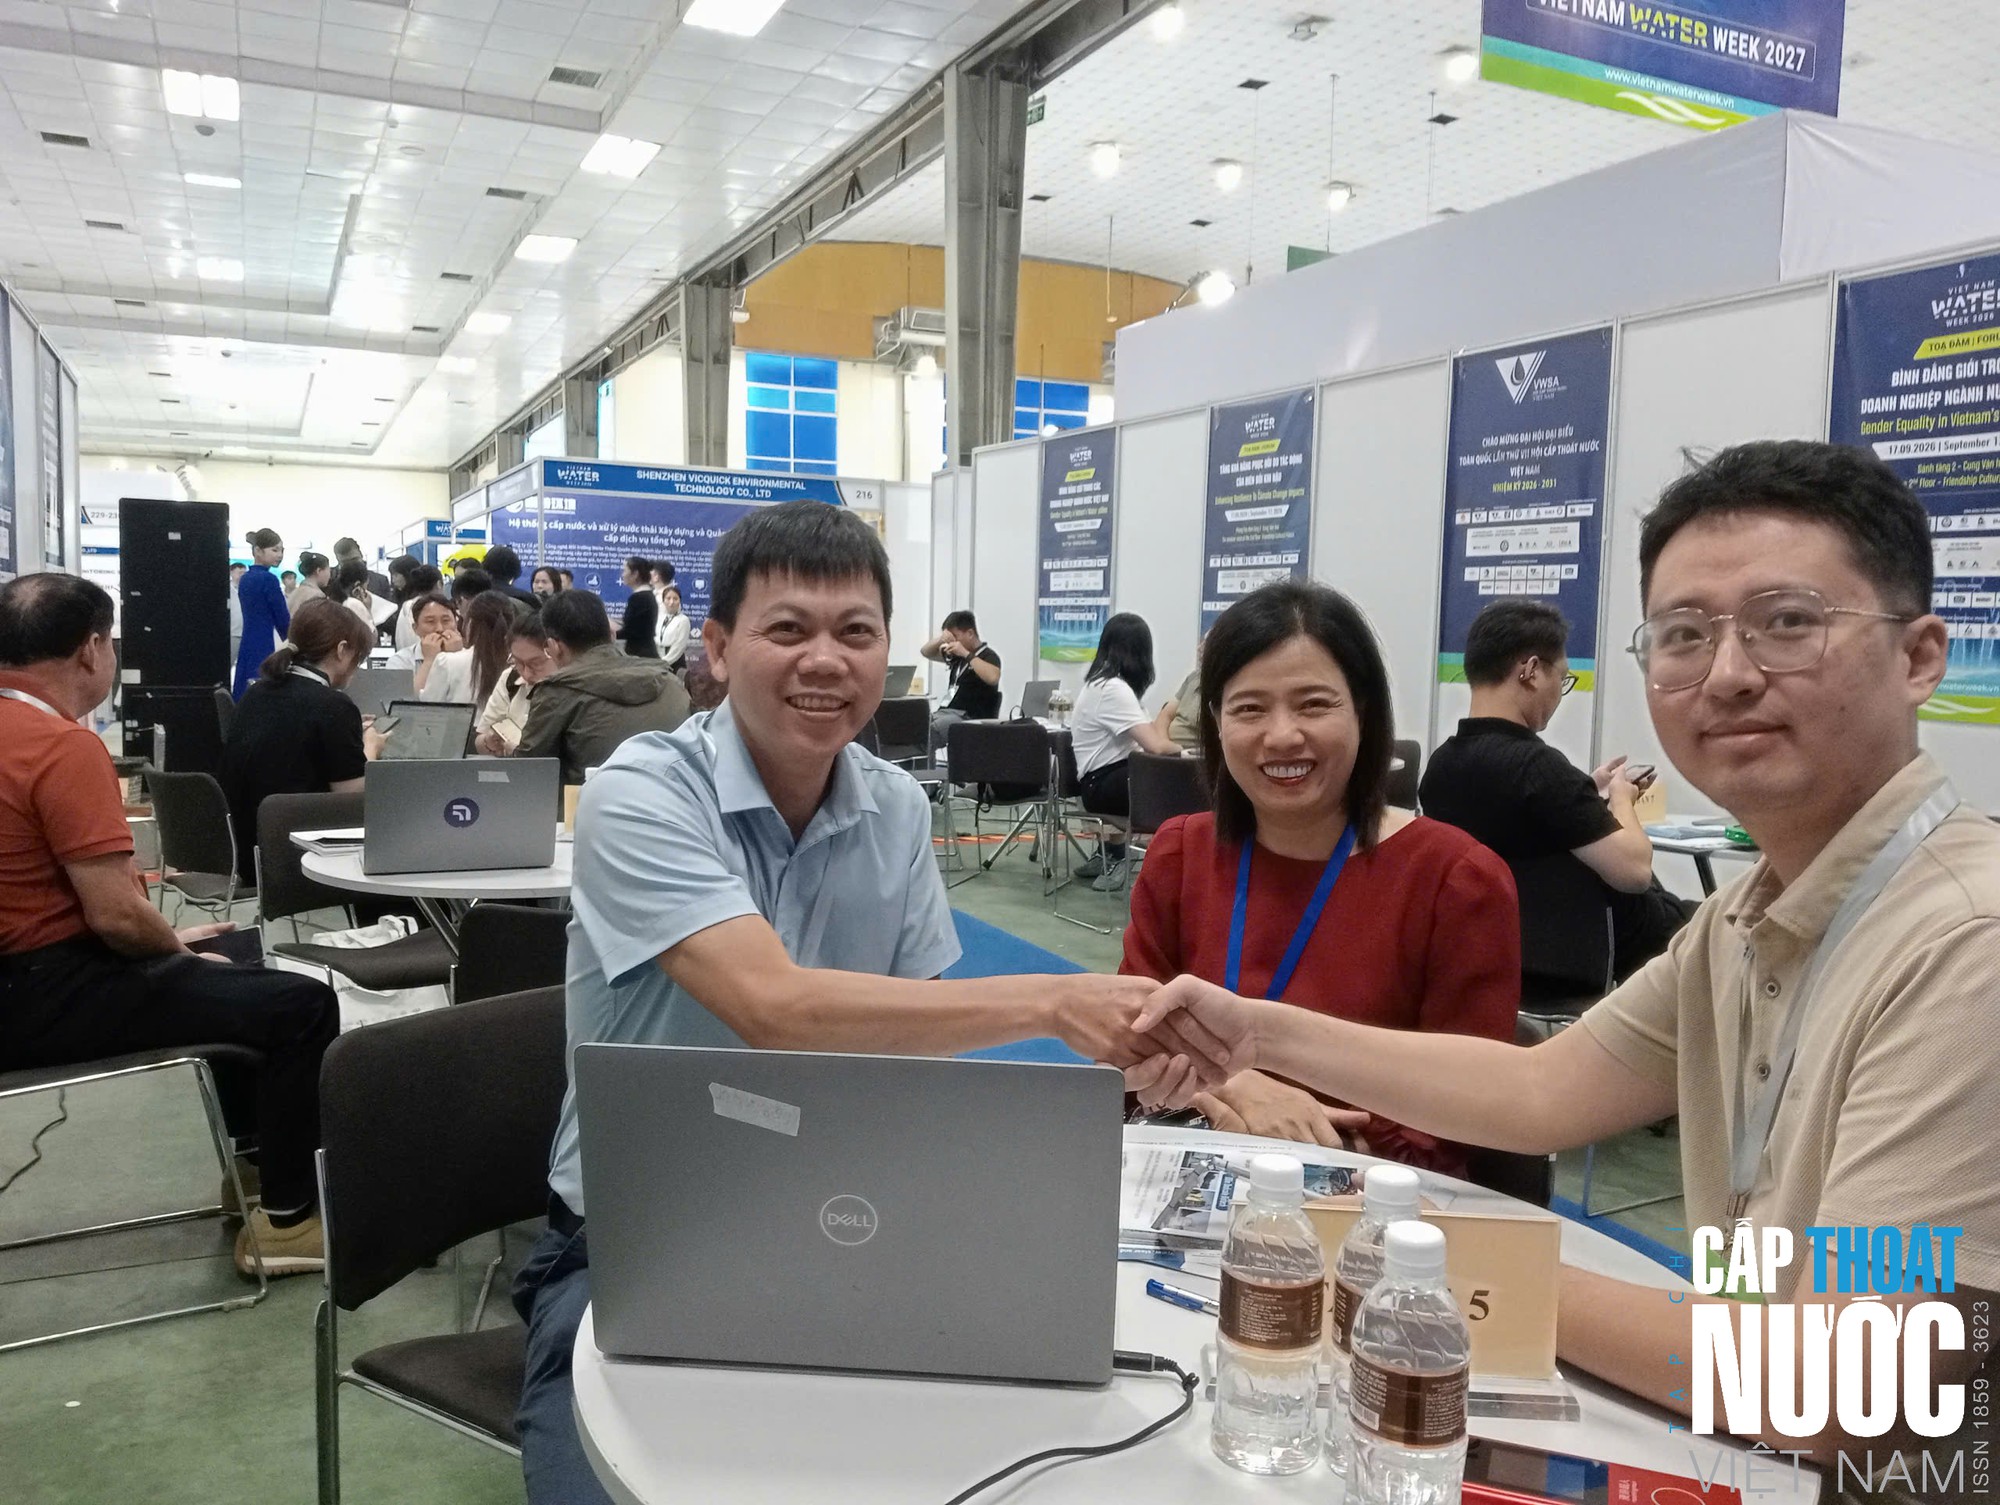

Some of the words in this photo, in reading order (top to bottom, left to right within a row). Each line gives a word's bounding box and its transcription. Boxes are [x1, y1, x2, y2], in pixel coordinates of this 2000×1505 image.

[1629, 3, 1708, 48] WATER
[1713, 25, 1761, 62] WEEK
[1764, 39, 1806, 72] 2027
[1604, 68, 1735, 109] www.vietnamwaterweek.vn
[1891, 367, 1920, 388] BÌNH
[1860, 395, 1898, 415] DOANH
[1899, 389, 1942, 411] NGHIỆP
[1944, 384, 1984, 406] NGÀNH
[1860, 420, 1894, 436] Gender
[1896, 414, 1936, 435] Equality
[1944, 437, 1990, 453] September
[557, 468, 600, 483] WATER
[636, 470, 687, 483] SHENZHEN
[688, 473, 732, 485] VICQUICK
[732, 476, 807, 491] ENVIRONMENTAL
[674, 483, 734, 496] TECHNOLOGY
[736, 488, 754, 498] CO.,
[755, 489, 771, 499] LTD
[856, 489, 873, 500] 216
[522, 517, 547, 531] thốg
[548, 519, 564, 531] cấp
[587, 521, 597, 531] và
[603, 533, 619, 544] cấp
[827, 1212, 873, 1228] DELL
[1468, 1289, 1490, 1321] 5
